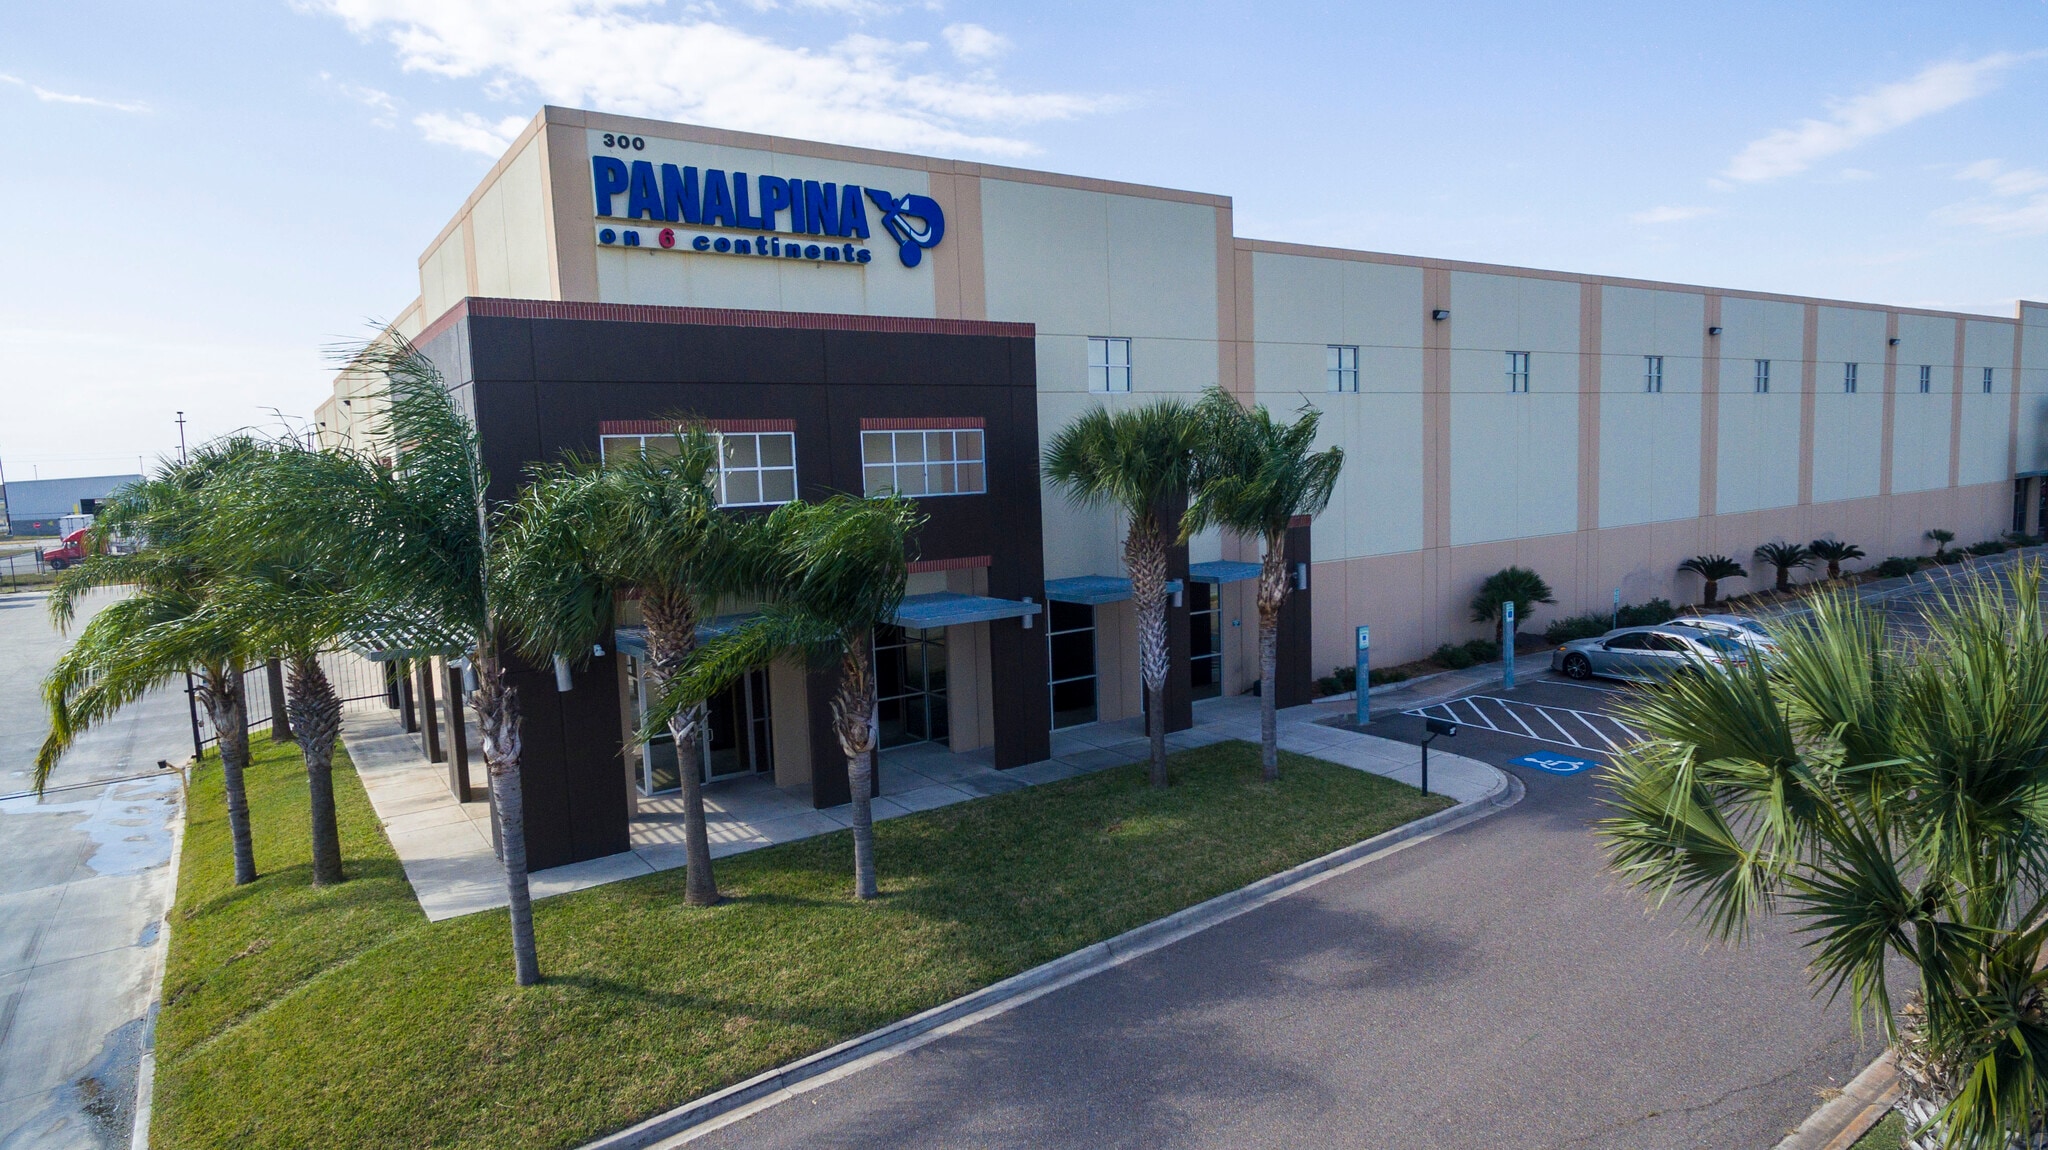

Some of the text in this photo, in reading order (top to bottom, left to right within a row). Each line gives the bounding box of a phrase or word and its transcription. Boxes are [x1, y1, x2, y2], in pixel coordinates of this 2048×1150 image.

[603, 133, 645, 151] 300
[592, 155, 870, 239] PANALPINA
[599, 227, 872, 264] on 6 continents
